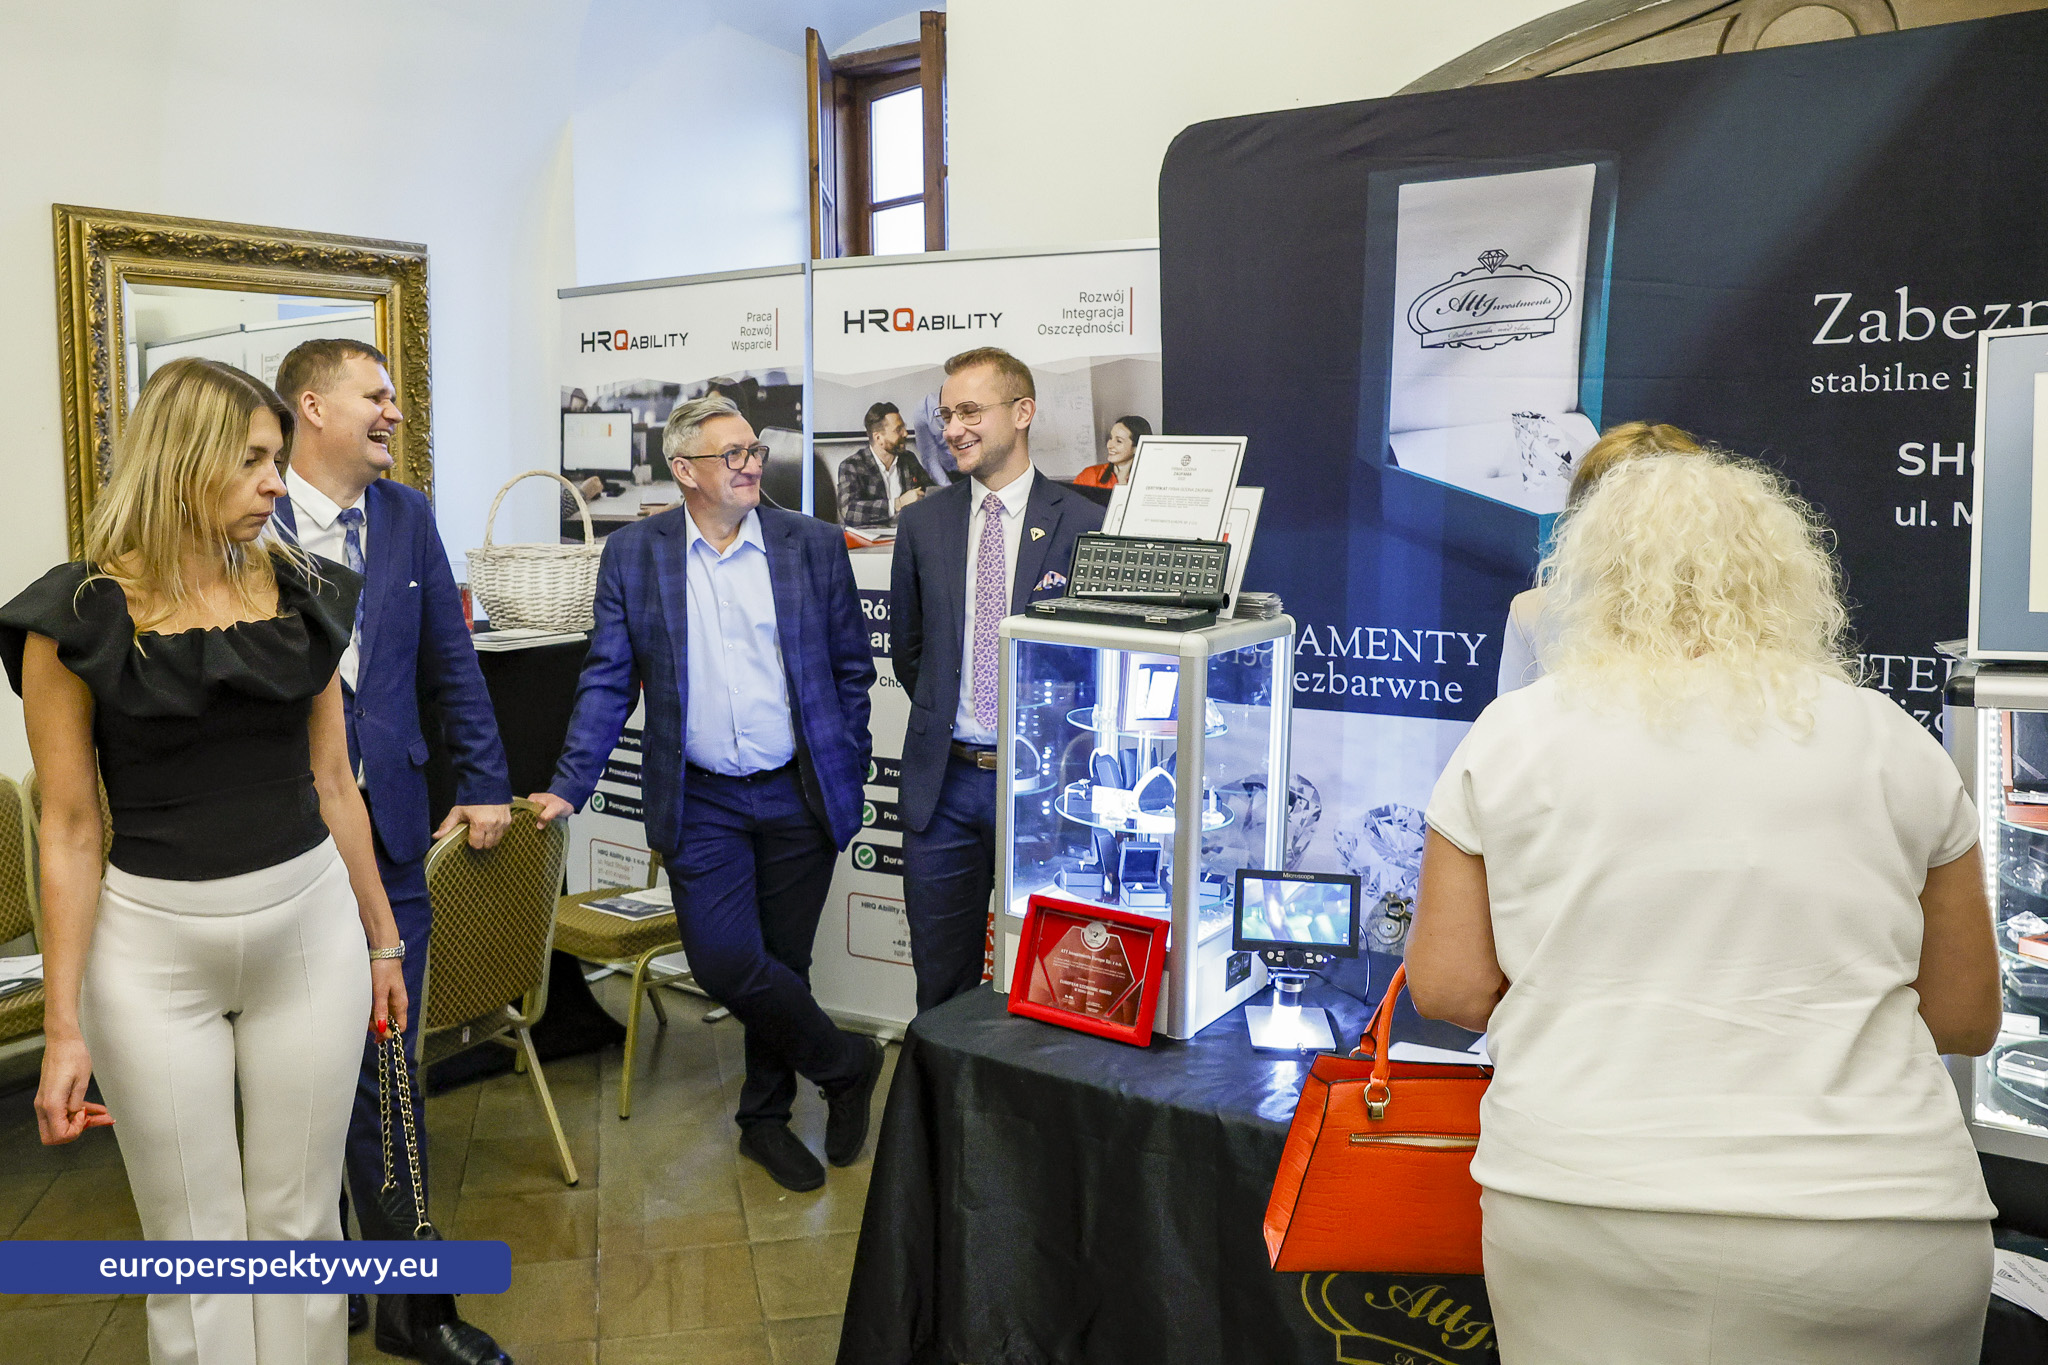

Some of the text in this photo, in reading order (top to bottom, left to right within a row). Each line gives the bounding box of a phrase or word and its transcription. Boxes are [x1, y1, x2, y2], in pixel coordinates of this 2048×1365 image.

[1079, 290, 1124, 304] Rozwój
[747, 312, 772, 322] Praca
[1062, 306, 1124, 321] Integracja
[740, 325, 772, 337] Rozwój
[1037, 321, 1124, 337] Oszczędności
[731, 340, 772, 352] Wsparcie
[1811, 362, 1977, 394] stabilne i
[1897, 442, 1975, 476] SH
[1895, 500, 1938, 527] ul.
[860, 598, 891, 620] Ró
[1294, 624, 1487, 666] AMENTY
[1293, 661, 1463, 704] ezbarwne
[884, 811, 899, 821] Pro
[1282, 872, 1315, 880] Microscope
[861, 902, 877, 910] HRQ
[878, 904, 901, 914] Ability
